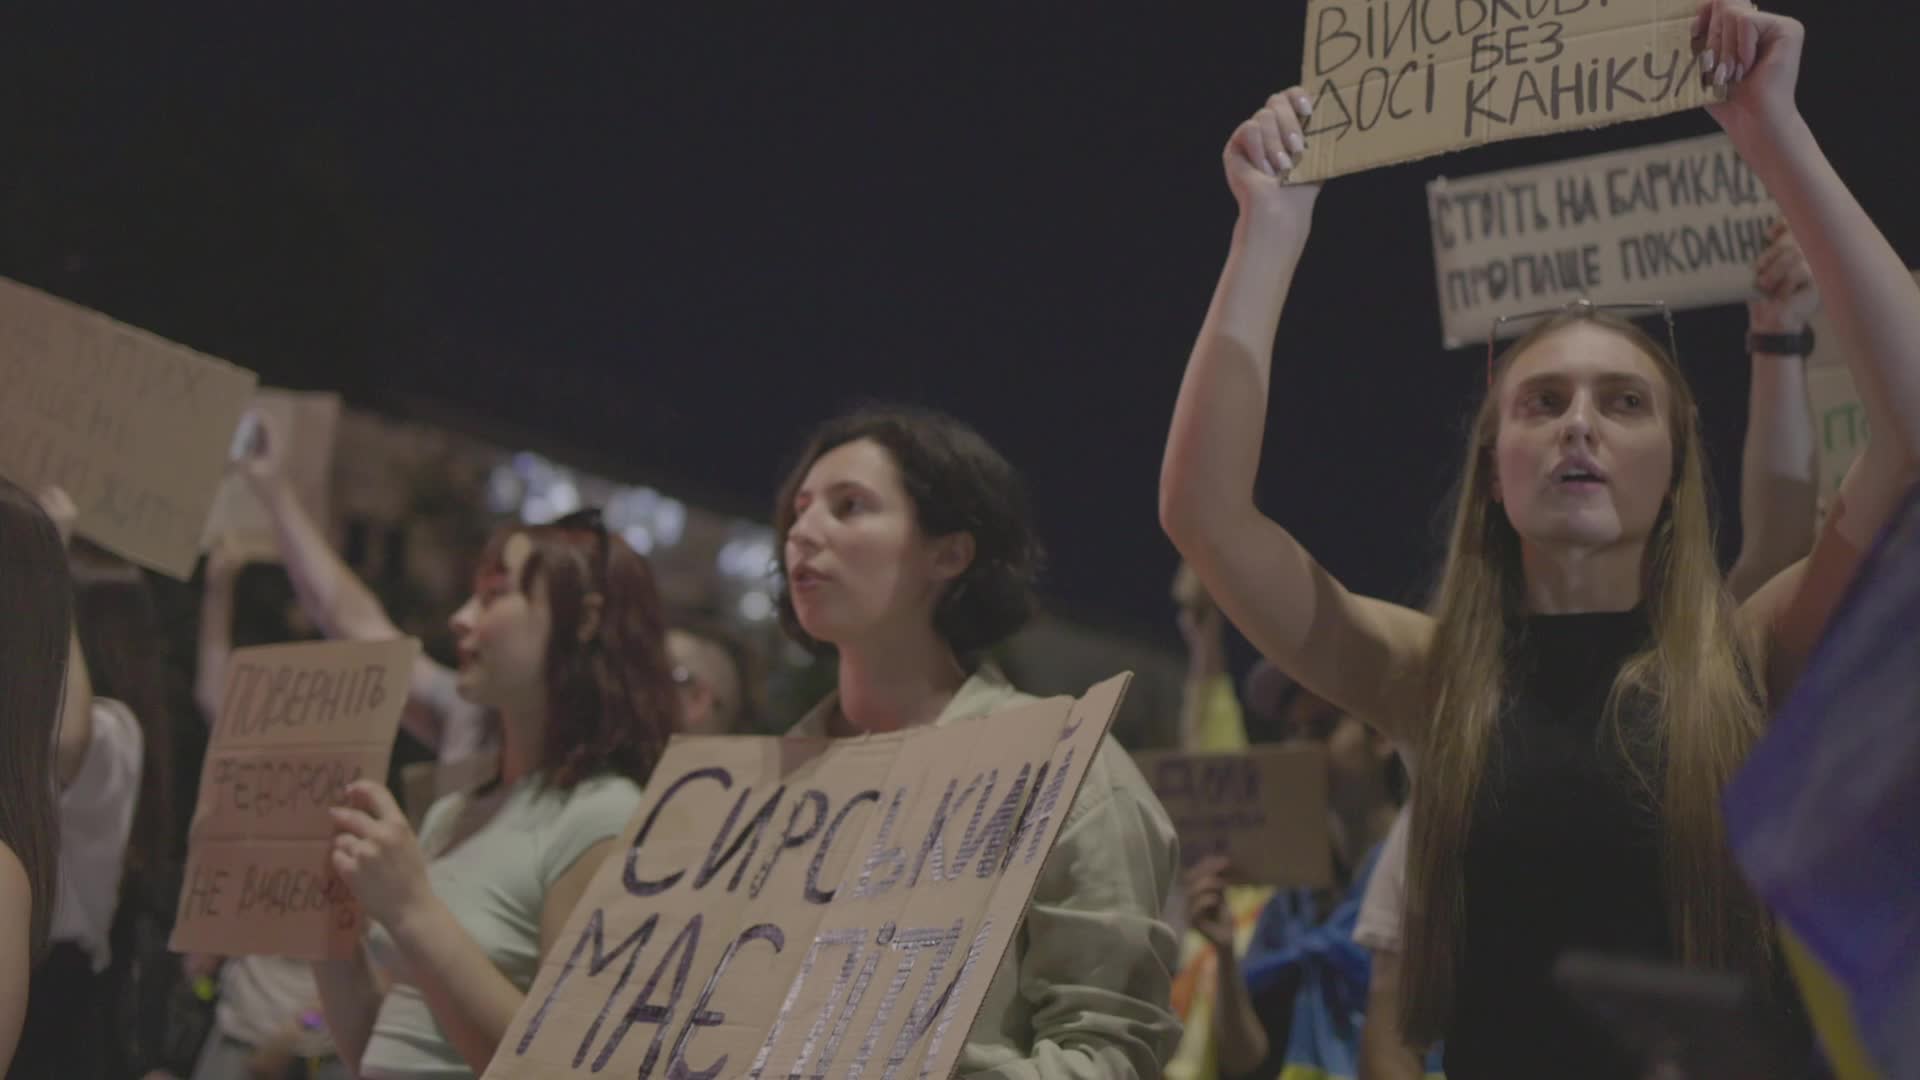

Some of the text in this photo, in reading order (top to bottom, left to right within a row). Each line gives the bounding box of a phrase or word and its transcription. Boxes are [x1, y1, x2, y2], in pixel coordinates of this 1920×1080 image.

[1470, 21, 1565, 74] БЕЗ
[1555, 173, 1600, 230] НА
[1447, 244, 1603, 311] ПРОПАЩЕ
[215, 663, 387, 741] ПОВЕРНІТЬ
[621, 718, 1084, 904] СИРСЬКИЙ
[184, 865, 231, 921] НЕ
[515, 908, 786, 1079] МАЄ
